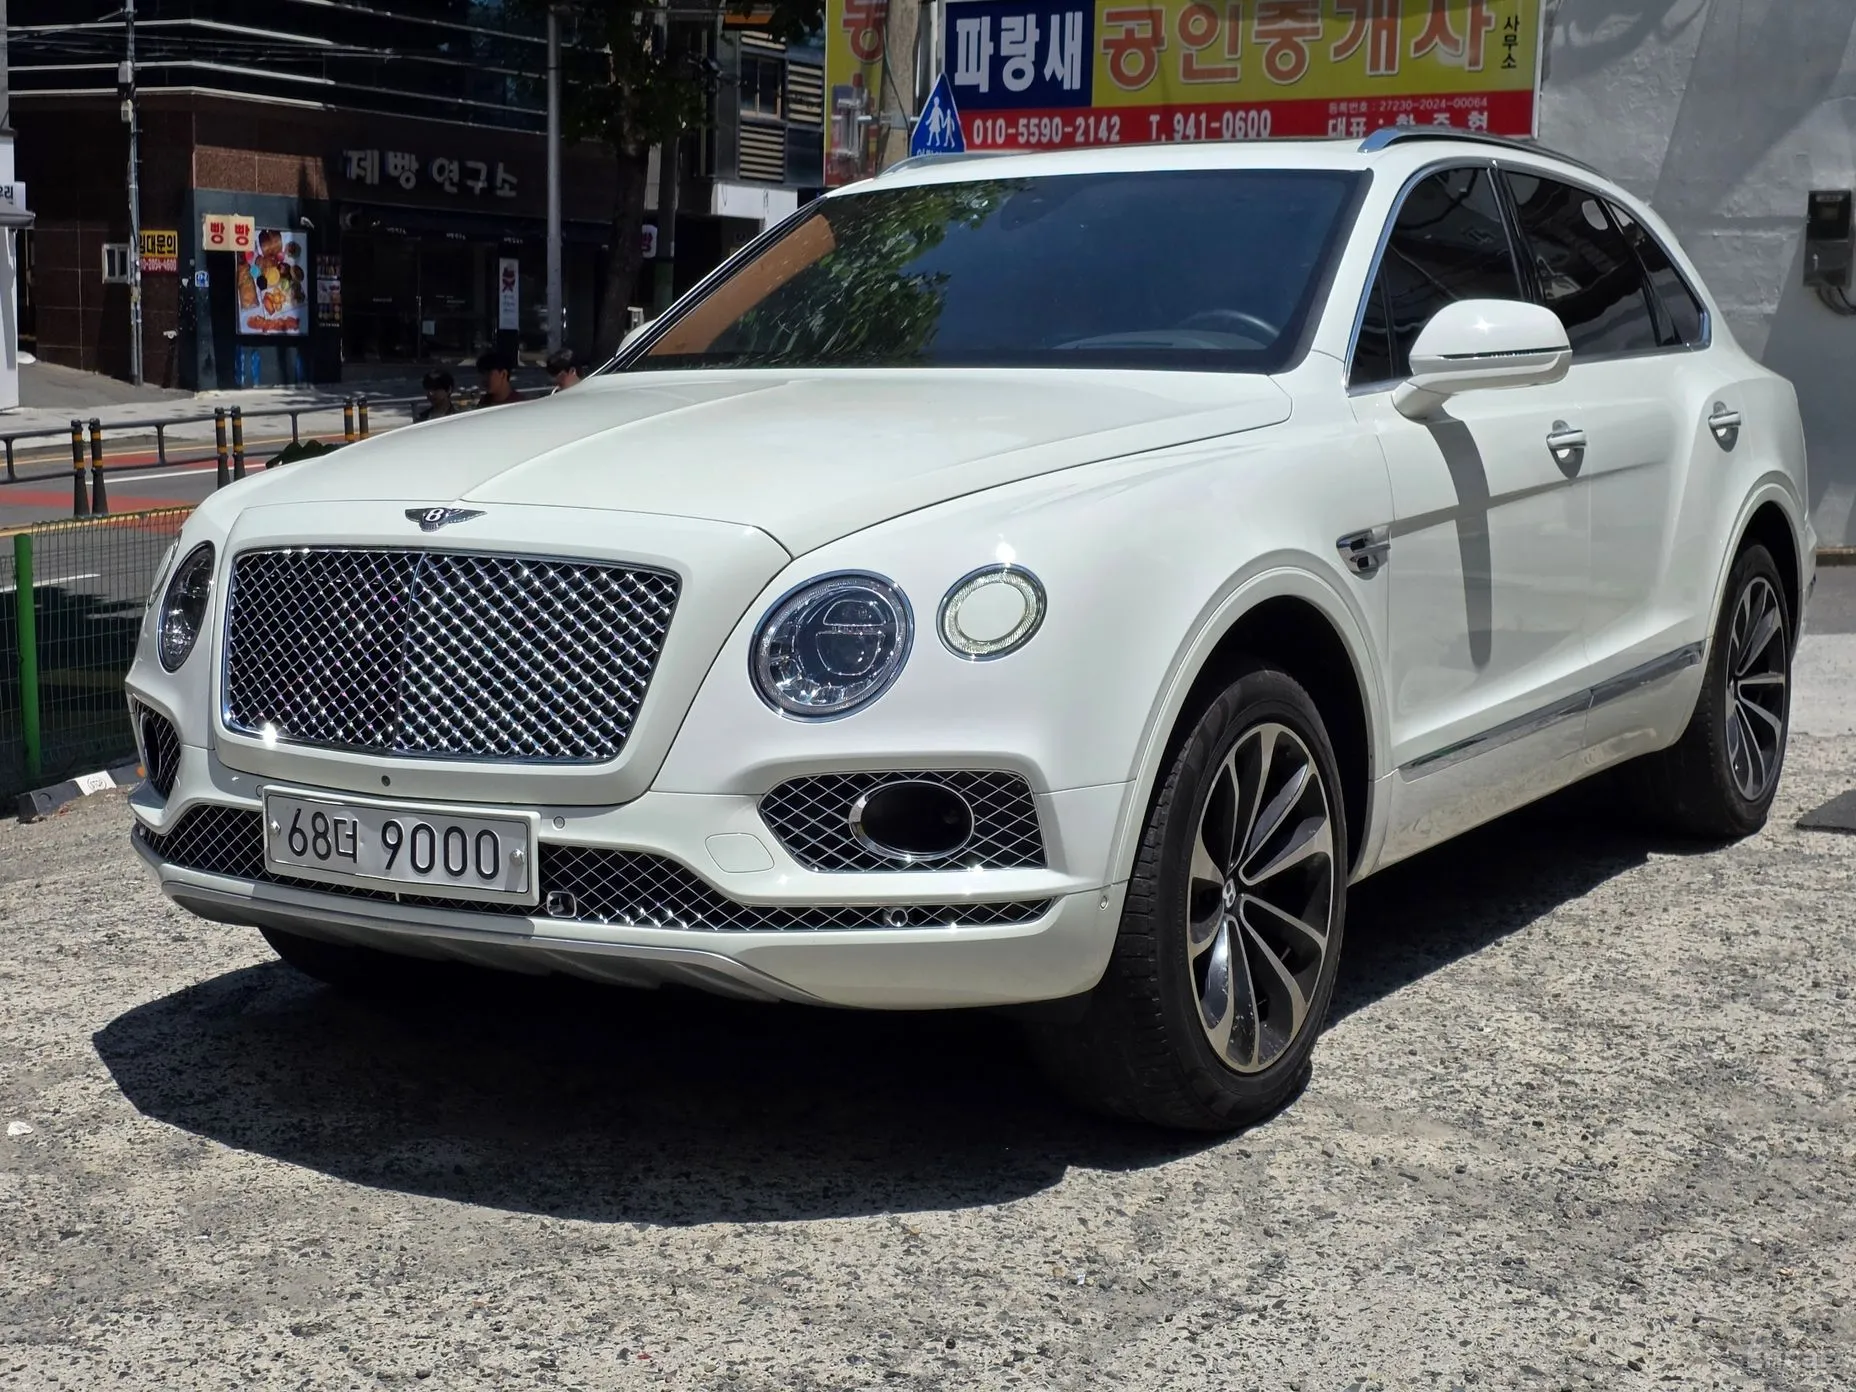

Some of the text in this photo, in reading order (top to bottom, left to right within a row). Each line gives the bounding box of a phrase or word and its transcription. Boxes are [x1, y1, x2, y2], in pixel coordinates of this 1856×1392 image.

[954, 11, 1083, 93] 파랑새
[1101, 0, 1496, 91] 공인중개사
[1501, 14, 1520, 69] 사무소
[972, 114, 1121, 145] 010-5590-2142
[210, 222, 250, 246] 빵 빵
[288, 808, 500, 880] 68더 9000
